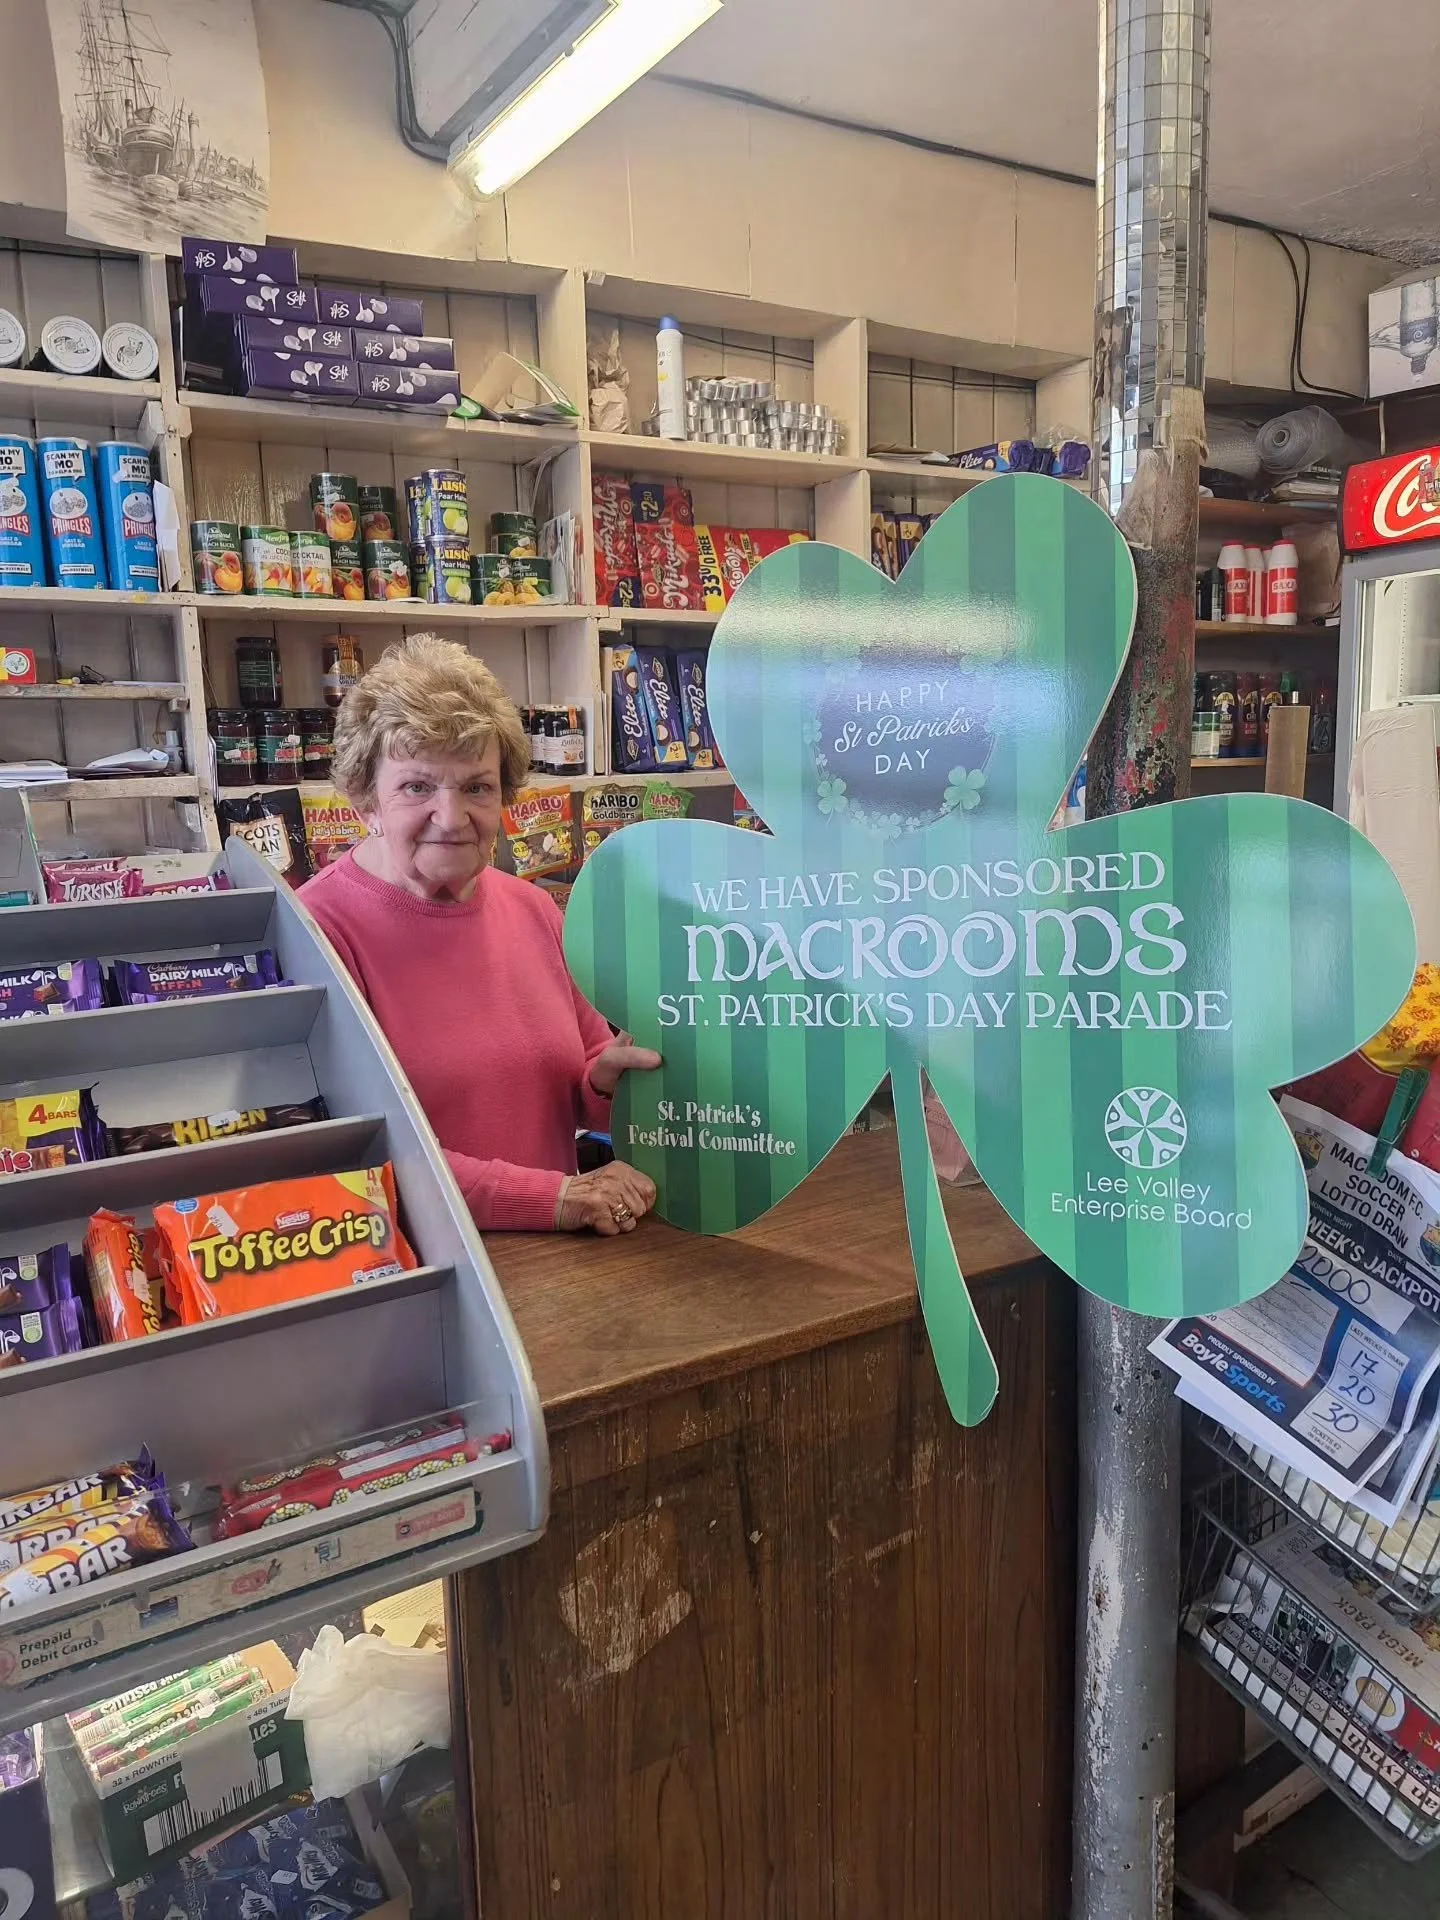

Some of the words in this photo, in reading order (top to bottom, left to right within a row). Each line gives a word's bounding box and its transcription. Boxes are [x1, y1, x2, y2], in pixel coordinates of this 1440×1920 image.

[194, 251, 216, 268] Soft
[286, 290, 307, 307] Soft
[330, 302, 350, 319] Soft
[322, 330, 342, 347] Soft
[364, 342, 384, 358] Soft
[329, 365, 349, 381] Soft
[370, 377, 391, 392] Soft
[54, 459, 74, 469] MO
[68, 451, 80, 460] MY
[131, 464, 147, 474] MO
[959, 452, 984, 470] Elite
[433, 479, 467, 492] Lustr
[438, 492, 454, 501] Pear
[51, 517, 91, 535] PRINGLES
[124, 519, 155, 536] PRINGL
[292, 552, 325, 561] COCKTAIL
[435, 547, 470, 560] Lustr
[697, 534, 714, 556] FREE
[440, 560, 455, 569] Pear
[655, 528, 690, 608] Mikado
[650, 678, 669, 720] Elite
[687, 683, 705, 728] Elite
[856, 679, 950, 714] HAPPY
[625, 693, 643, 738] Elite
[834, 720, 864, 753] St
[867, 706, 975, 748] Patrick's
[875, 748, 932, 775] DAY
[508, 796, 563, 820] HARIBO
[590, 793, 639, 809] HARIBO
[235, 822, 280, 841] SCOTS
[59, 877, 125, 902] TURKISH
[692, 879, 751, 913] WE
[758, 871, 863, 910] HAVE
[872, 850, 1166, 905] SPONSORED
[681, 902, 1188, 983] MACROOMS
[147, 962, 189, 975] Cadbury
[149, 970, 190, 983] DAIRY
[191, 965, 224, 979] MILK
[152, 979, 203, 991] TIFFIN
[656, 993, 710, 1027] ST.
[718, 992, 915, 1028] PATRICK'S
[925, 991, 1016, 1029] DAY
[1025, 989, 1234, 1031] PARADE
[27, 1103, 48, 1125] 4
[47, 1109, 77, 1121] BARS
[657, 1099, 681, 1122] St.
[684, 1101, 762, 1128] Patrick's
[627, 1124, 694, 1148] Festival
[698, 1128, 797, 1156] Committee
[366, 1168, 377, 1185] 4
[1329, 1140, 1410, 1200] MACOM
[1086, 1171, 1129, 1194] Lee
[1136, 1175, 1212, 1205] Valley
[1345, 1173, 1406, 1221] SOCCER
[1051, 1192, 1166, 1223] Enterprise
[1174, 1203, 1252, 1230] Board
[1320, 1179, 1373, 1219] LOTTO
[1372, 1211, 1410, 1250] DRAW
[1307, 1215, 1366, 1265] WEEK'S
[1363, 1253, 1440, 1314] JACKPOT
[1181, 1332, 1287, 1415] BoyleSports
[1207, 1334, 1233, 1356] PROUDLY
[1232, 1351, 1268, 1381] SPONSORED
[1266, 1376, 1278, 1387] BY
[1350, 1349, 1380, 1376] 17
[1337, 1374, 1376, 1406] 20
[1311, 1401, 1359, 1434] 30
[0, 1472, 104, 1530] RBAR
[40, 1535, 134, 1595] BAR
[1333, 1596, 1377, 1631] PACK
[19, 1628, 73, 1656] Prepaid
[20, 1650, 60, 1671] Debit
[61, 1637, 99, 1657] Cards
[1377, 1629, 1425, 1668] MEGA
[1267, 1665, 1336, 1723] ACTONER
[1346, 1731, 1407, 1790] Lynch
[111, 1775, 123, 1788] 32
